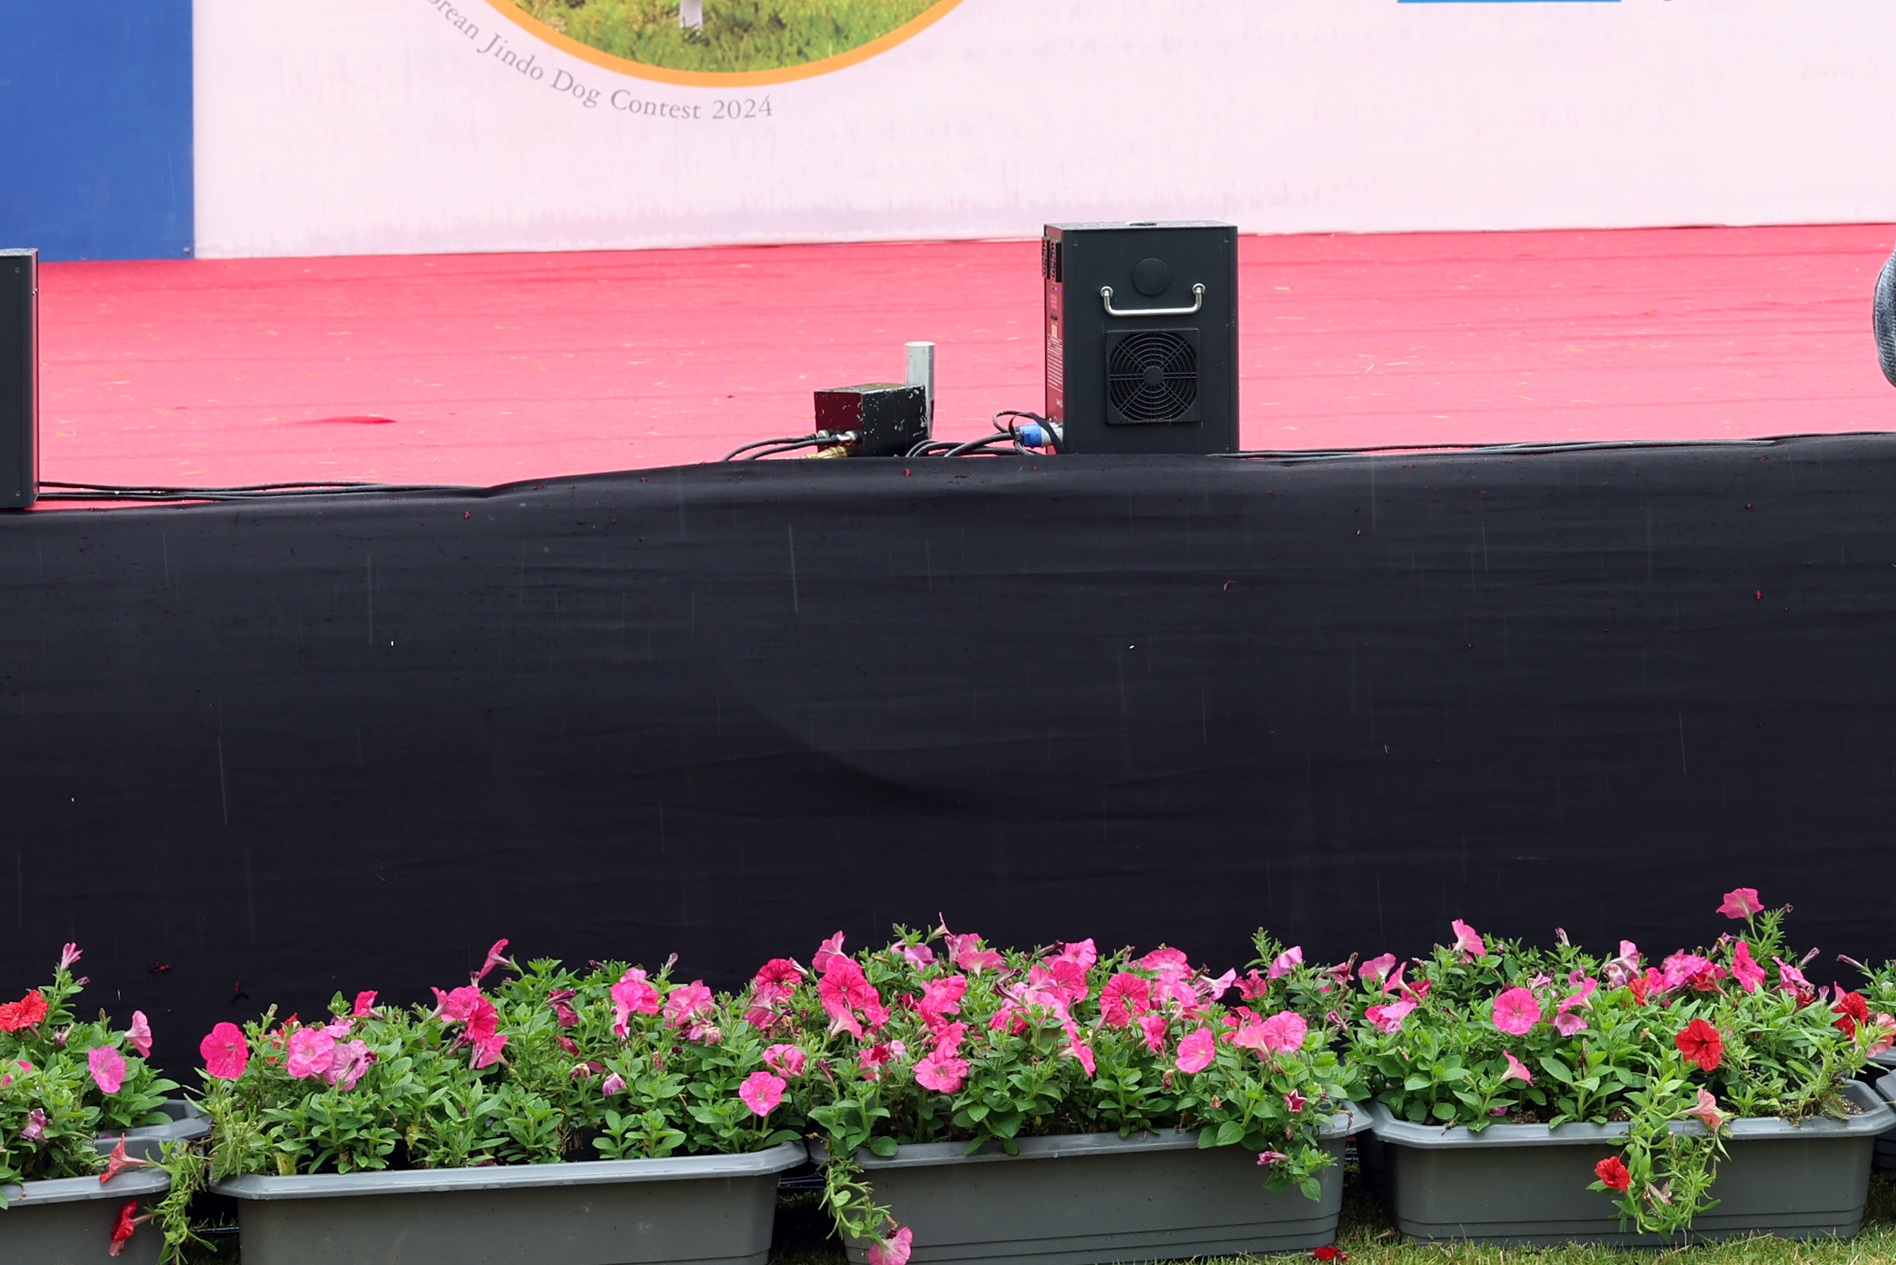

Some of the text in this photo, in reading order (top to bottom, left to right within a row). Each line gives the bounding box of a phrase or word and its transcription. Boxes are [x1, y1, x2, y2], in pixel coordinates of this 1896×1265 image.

[477, 33, 545, 82] Jindo
[550, 68, 602, 109] Dog
[610, 89, 702, 121] Contest
[711, 95, 774, 120] 2024
